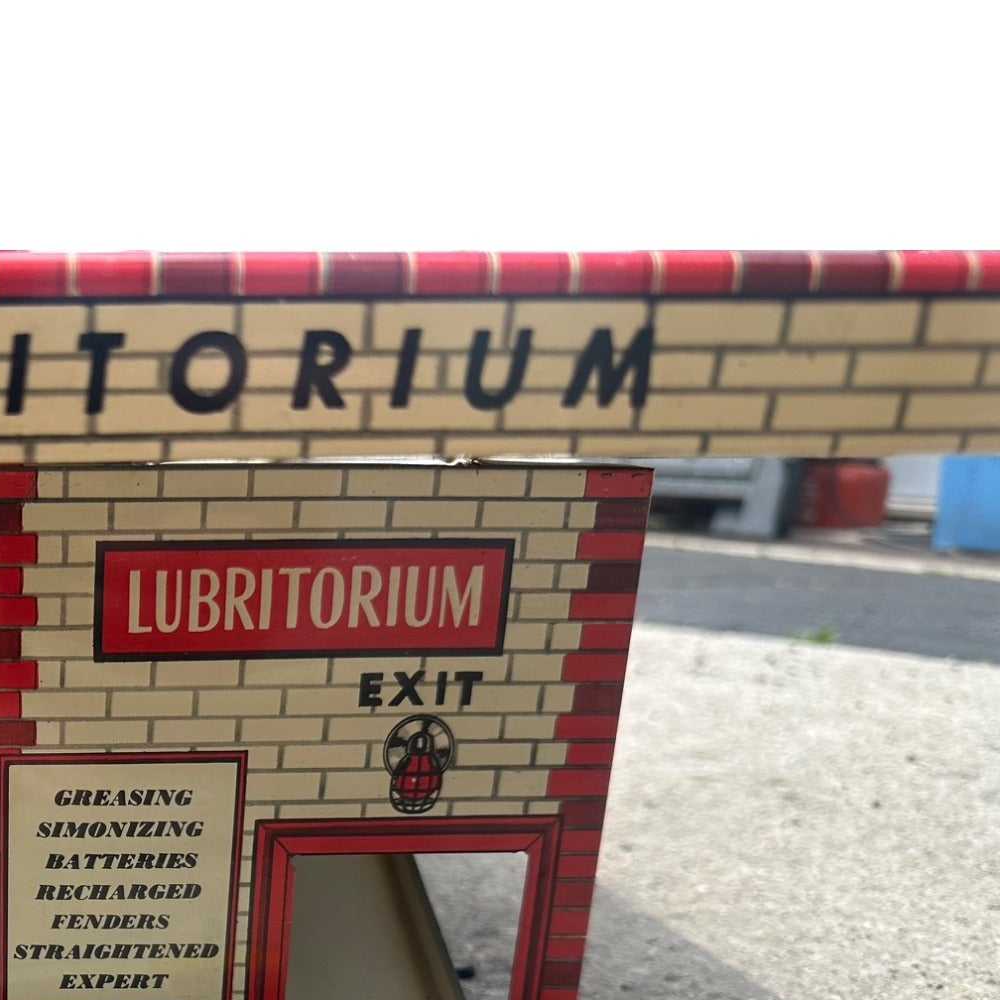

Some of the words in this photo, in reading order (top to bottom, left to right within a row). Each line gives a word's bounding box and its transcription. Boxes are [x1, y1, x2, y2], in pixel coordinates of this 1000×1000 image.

[127, 564, 485, 634] LUBRITORIUM
[357, 670, 484, 709] EXIT
[53, 789, 194, 807] GREASING
[35, 821, 205, 839] SIMONIZING
[44, 852, 199, 870] BATTERIES
[34, 883, 202, 901] RECHARGED
[50, 914, 171, 930] FENDERS
[13, 943, 220, 960] STRAIGHTENED
[58, 973, 170, 990] EXPERT
